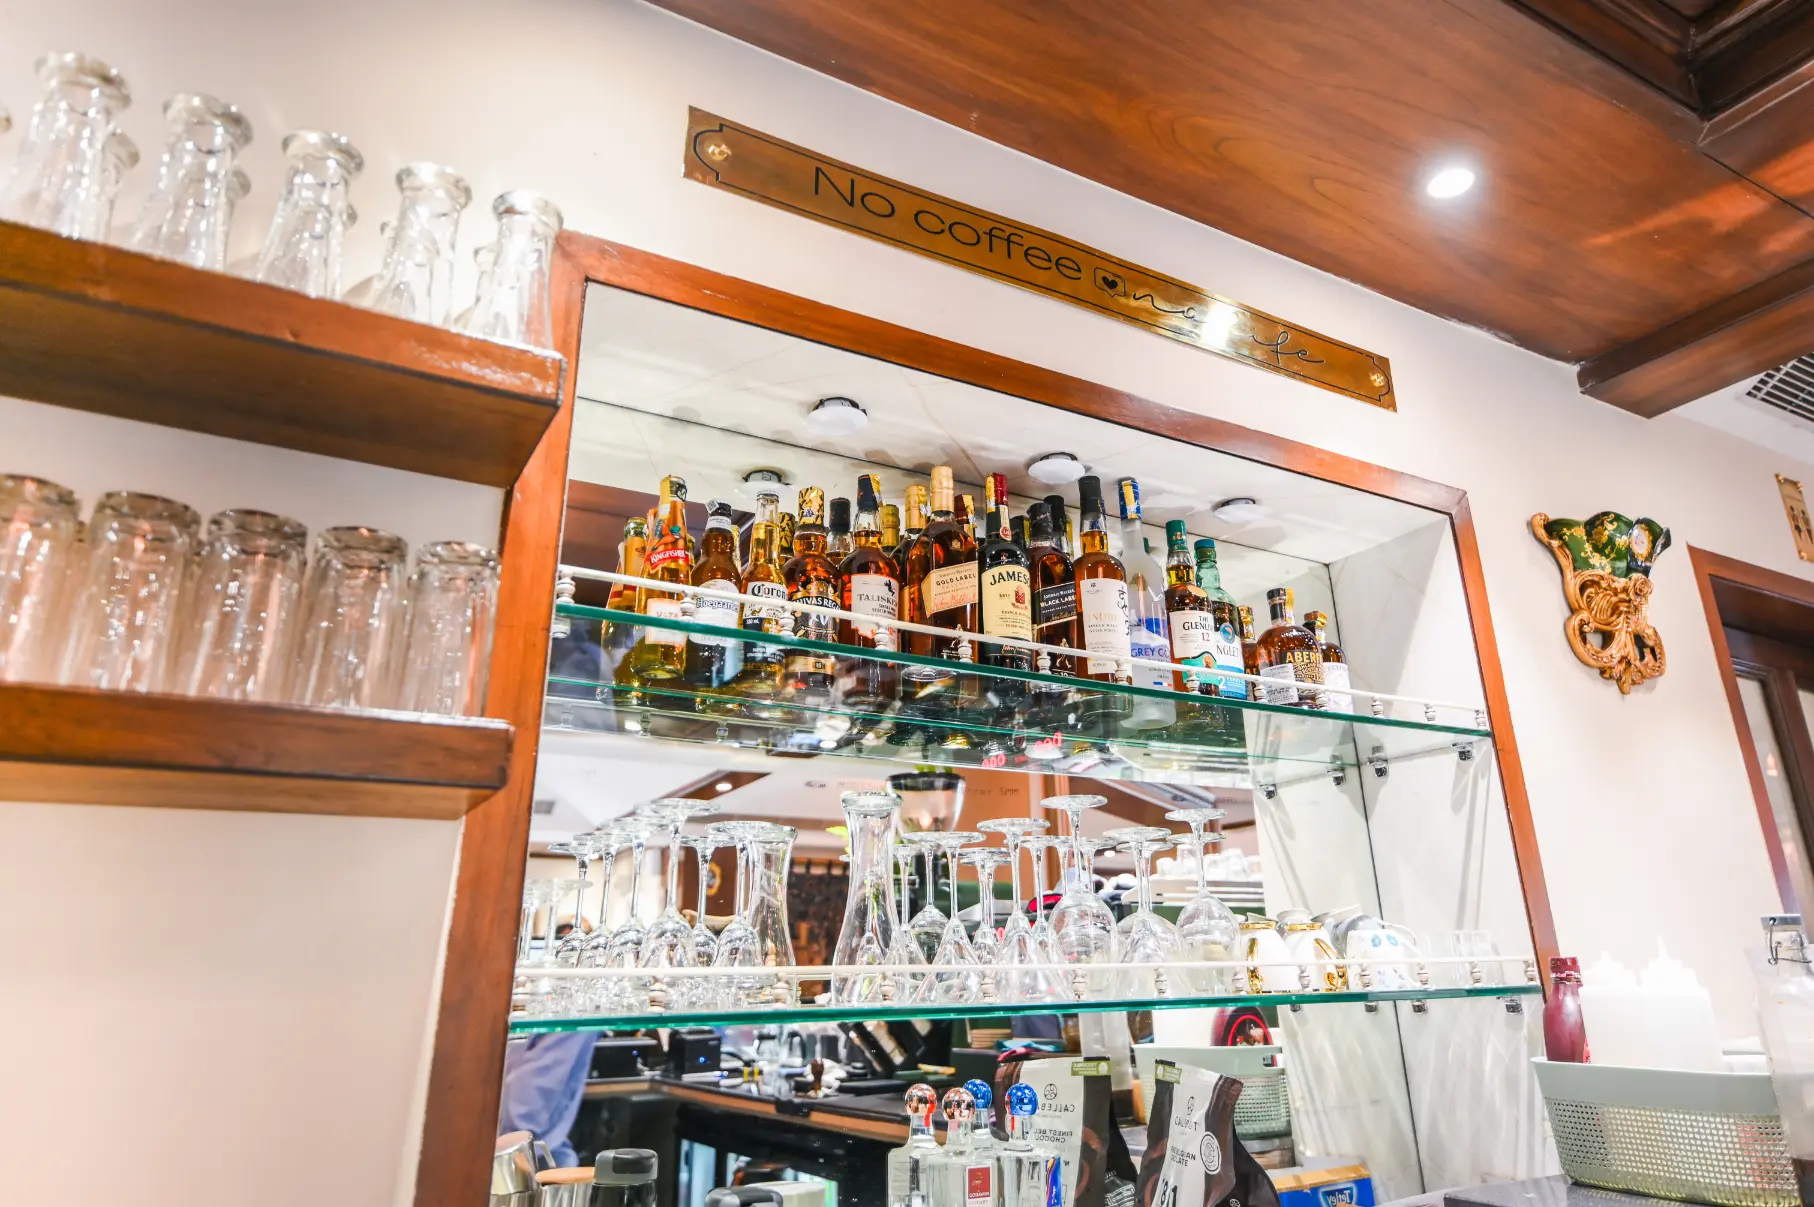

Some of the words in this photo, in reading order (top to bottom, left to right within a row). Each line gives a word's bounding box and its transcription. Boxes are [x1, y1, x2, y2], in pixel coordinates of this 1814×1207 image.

[814, 166, 895, 219] No
[913, 206, 1082, 281] coffee
[935, 577, 954, 586] GOLD
[955, 573, 976, 582] LABEL
[751, 583, 788, 602] Coron
[1040, 598, 1060, 607] BLACK
[1201, 632, 1211, 642] 12
[1130, 648, 1155, 658] GREY
